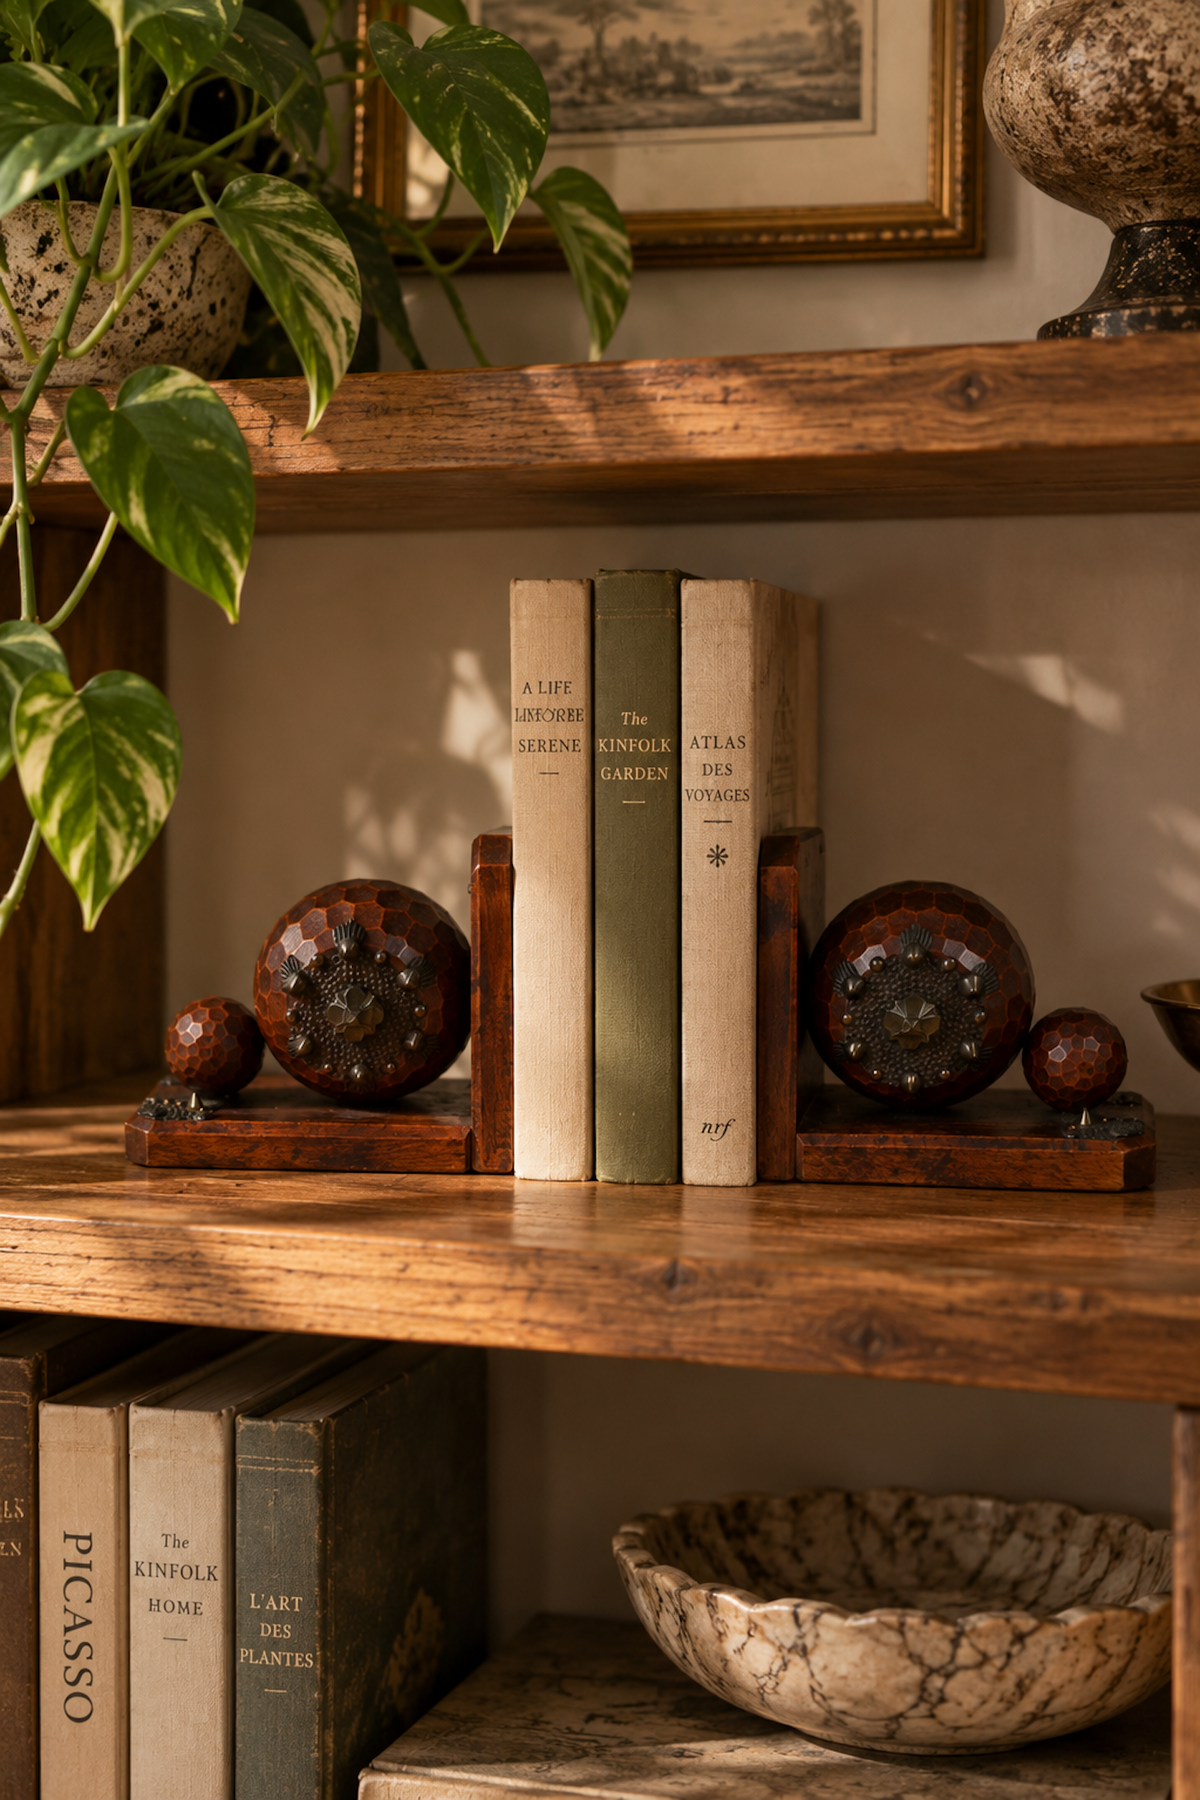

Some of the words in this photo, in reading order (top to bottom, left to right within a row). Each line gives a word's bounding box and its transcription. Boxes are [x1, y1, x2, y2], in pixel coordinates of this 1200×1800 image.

[522, 682, 532, 694] A
[538, 681, 572, 695] LIFE
[621, 712, 648, 725] The
[519, 739, 581, 753] SERENE
[599, 738, 671, 753] KINFOLK
[690, 736, 746, 749] ATLAS
[601, 767, 668, 781] GARDEN
[702, 763, 732, 776] DES
[685, 789, 750, 802] VOYAGES
[701, 1118, 736, 1142] nrf
[161, 1533, 189, 1550] The
[134, 1561, 219, 1582] KINFOLK
[148, 1598, 203, 1616] HOME
[250, 1593, 303, 1612] L'ART
[62, 1530, 94, 1723] PICASSO
[260, 1624, 291, 1638] DES
[240, 1648, 314, 1669] PLANTES
